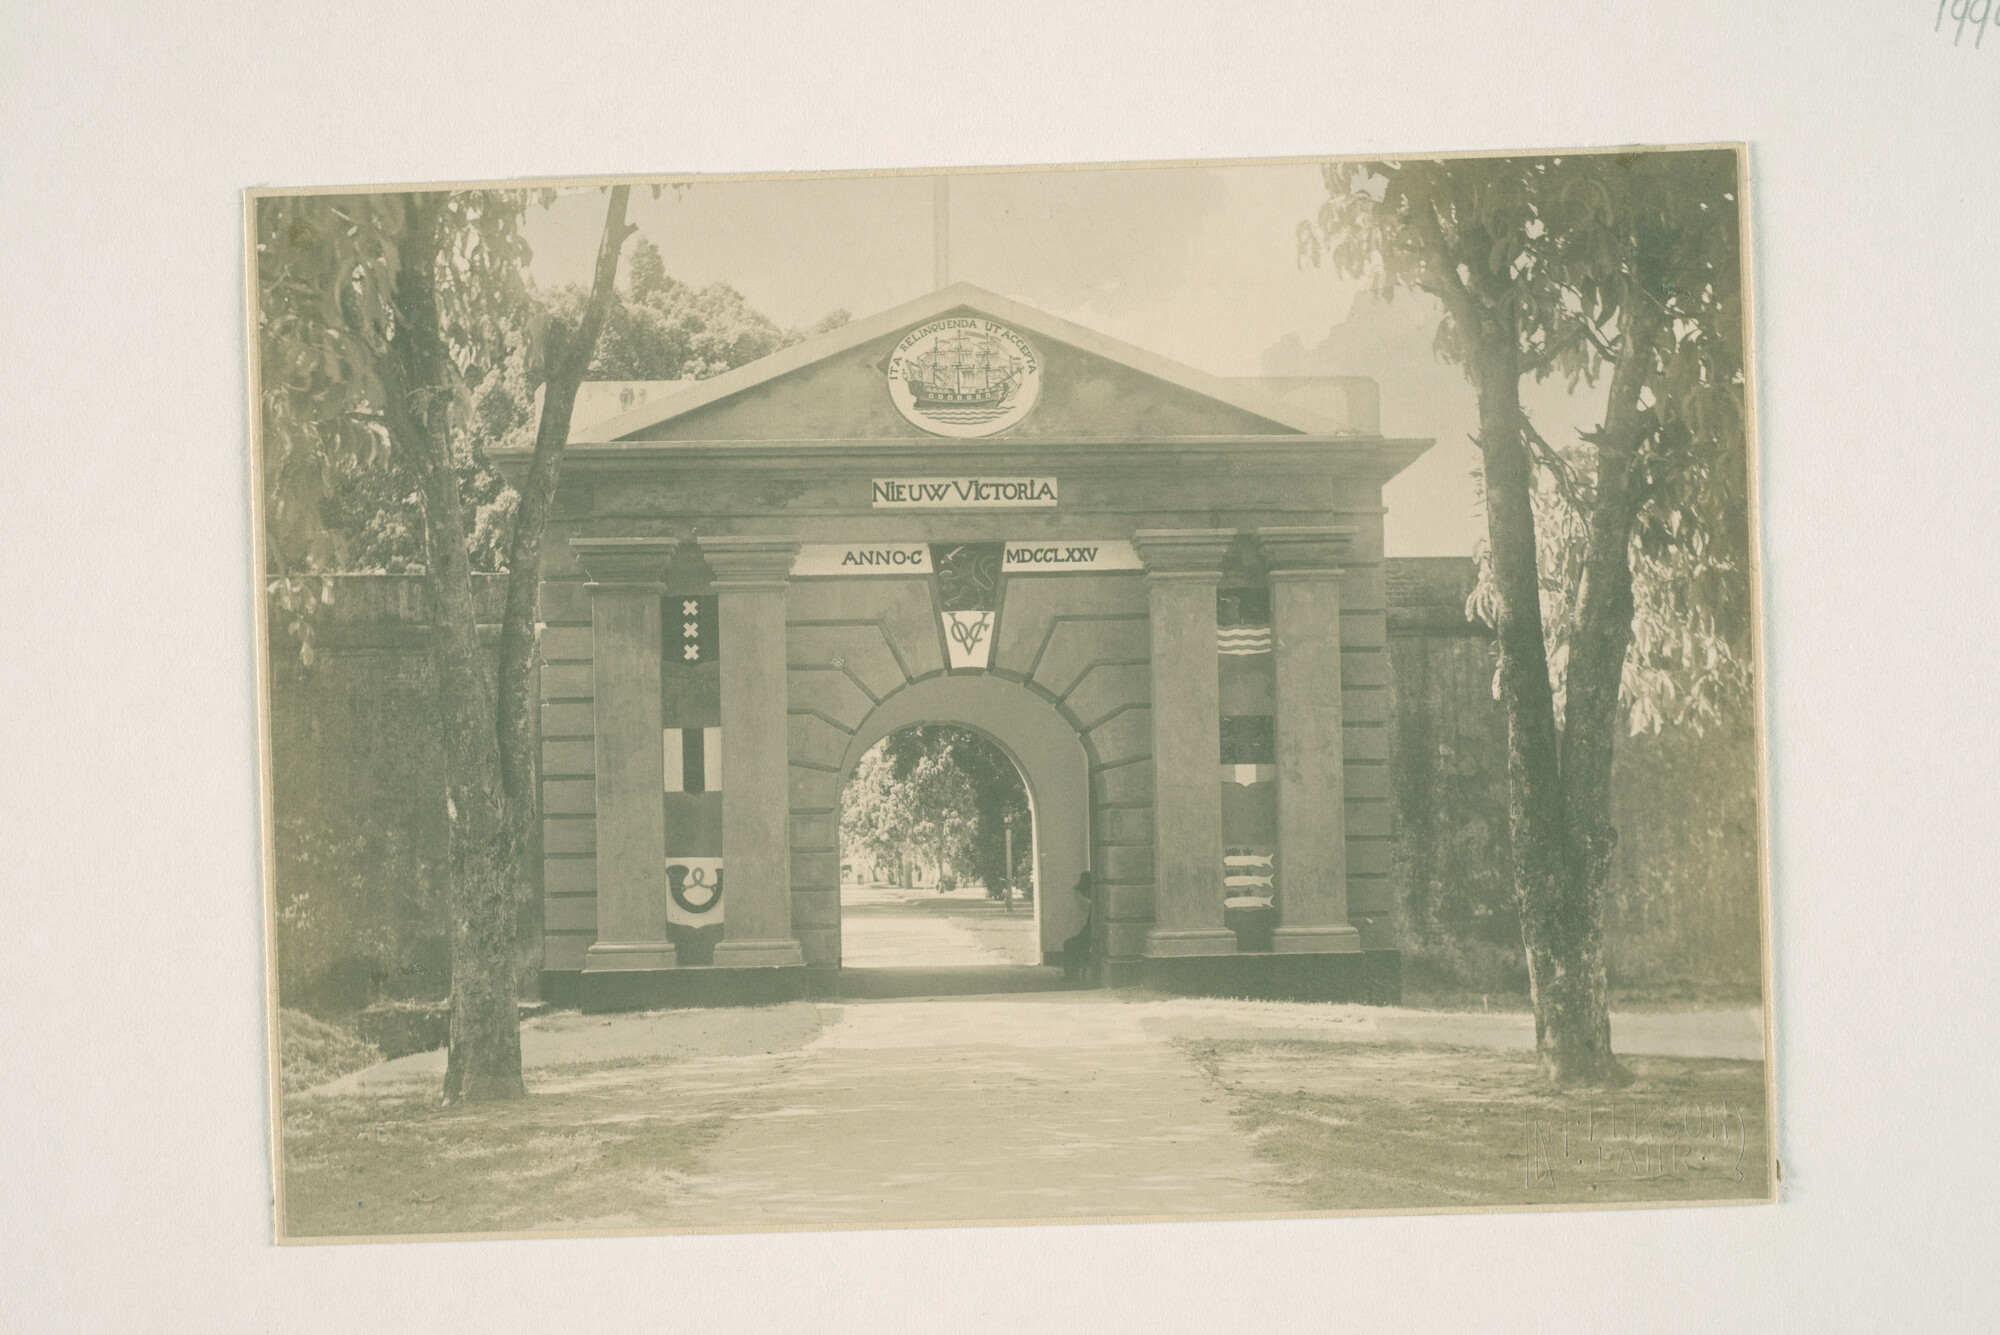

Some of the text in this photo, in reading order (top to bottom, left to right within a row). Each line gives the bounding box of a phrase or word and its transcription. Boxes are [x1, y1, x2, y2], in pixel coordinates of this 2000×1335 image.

[1934, 0, 2000, 49] 199
[889, 319, 1038, 381] ITA RELINQUENDA UT ACCEPTA
[872, 479, 1058, 502] NIEUW VICTORIA
[1006, 547, 1099, 563] MDCCLXXV
